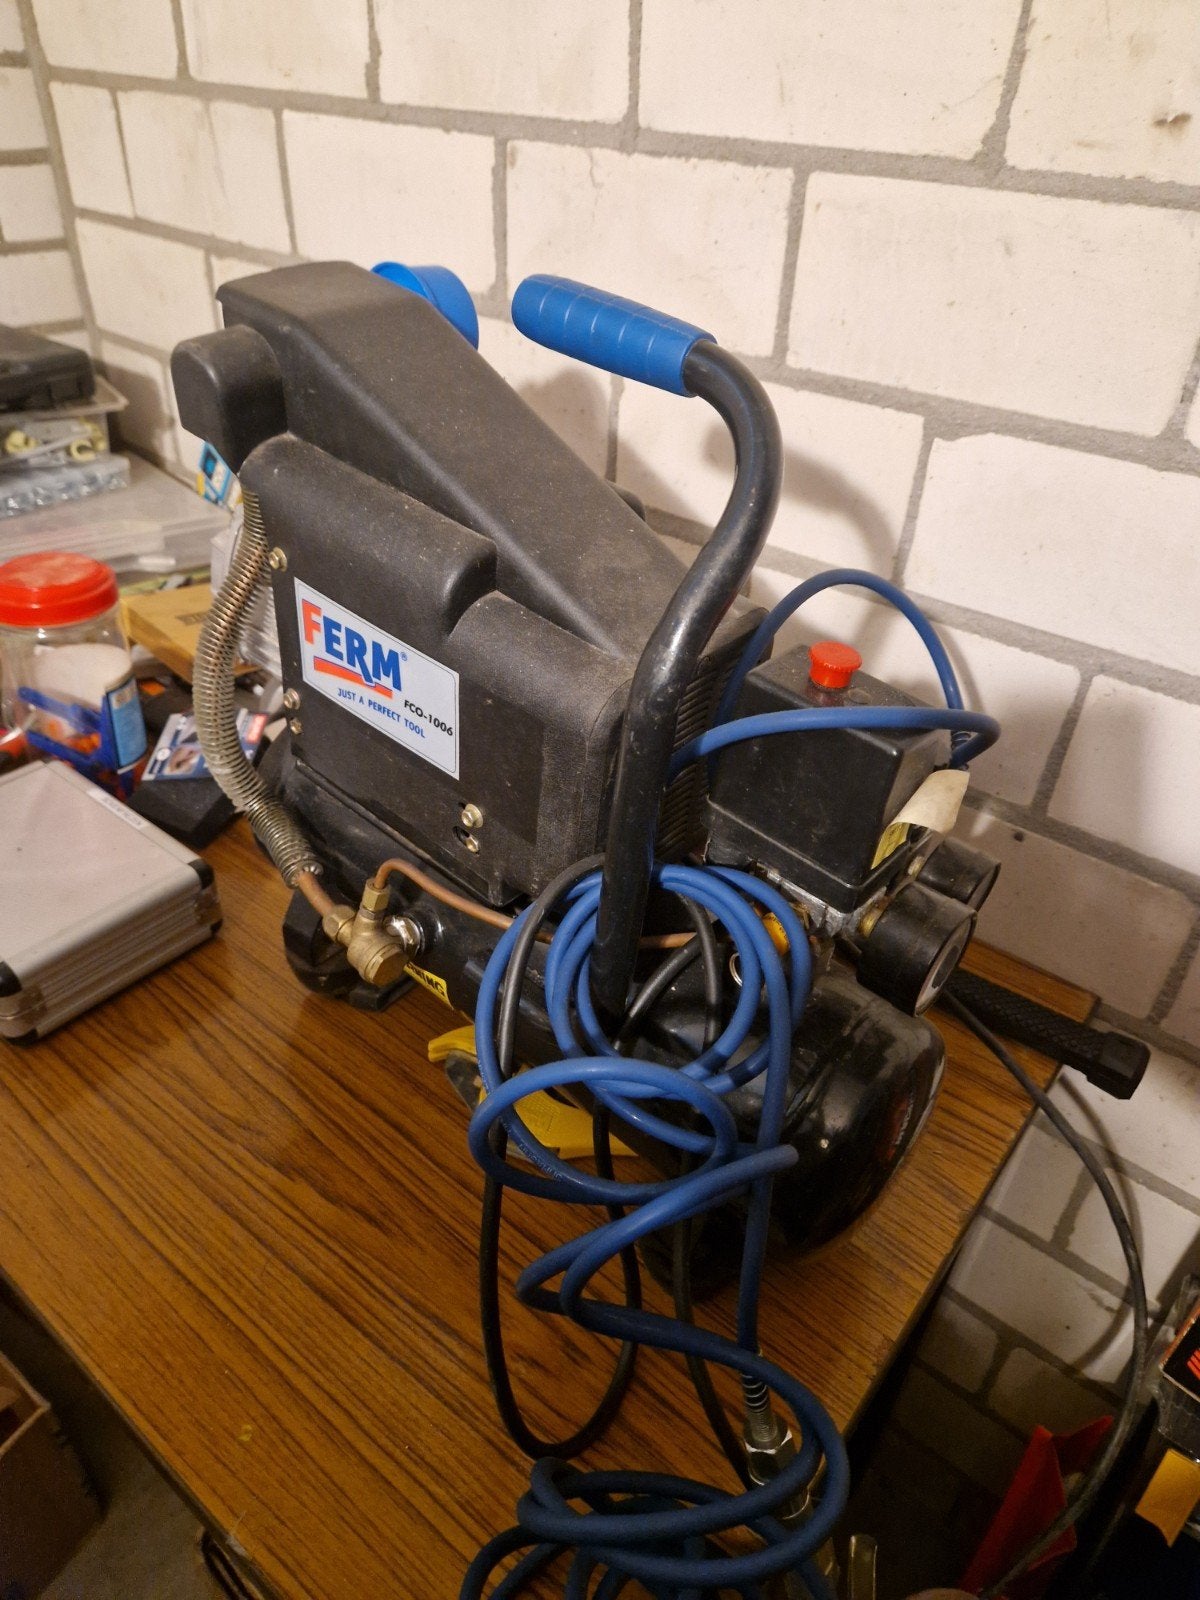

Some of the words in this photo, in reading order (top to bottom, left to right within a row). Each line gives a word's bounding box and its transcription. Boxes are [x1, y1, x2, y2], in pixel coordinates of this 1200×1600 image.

[338, 688, 356, 700] JUST
[359, 696, 365, 705] A
[368, 700, 401, 722] PERFECT
[404, 718, 426, 738] TOOL
[404, 700, 453, 736] FCO-1006
